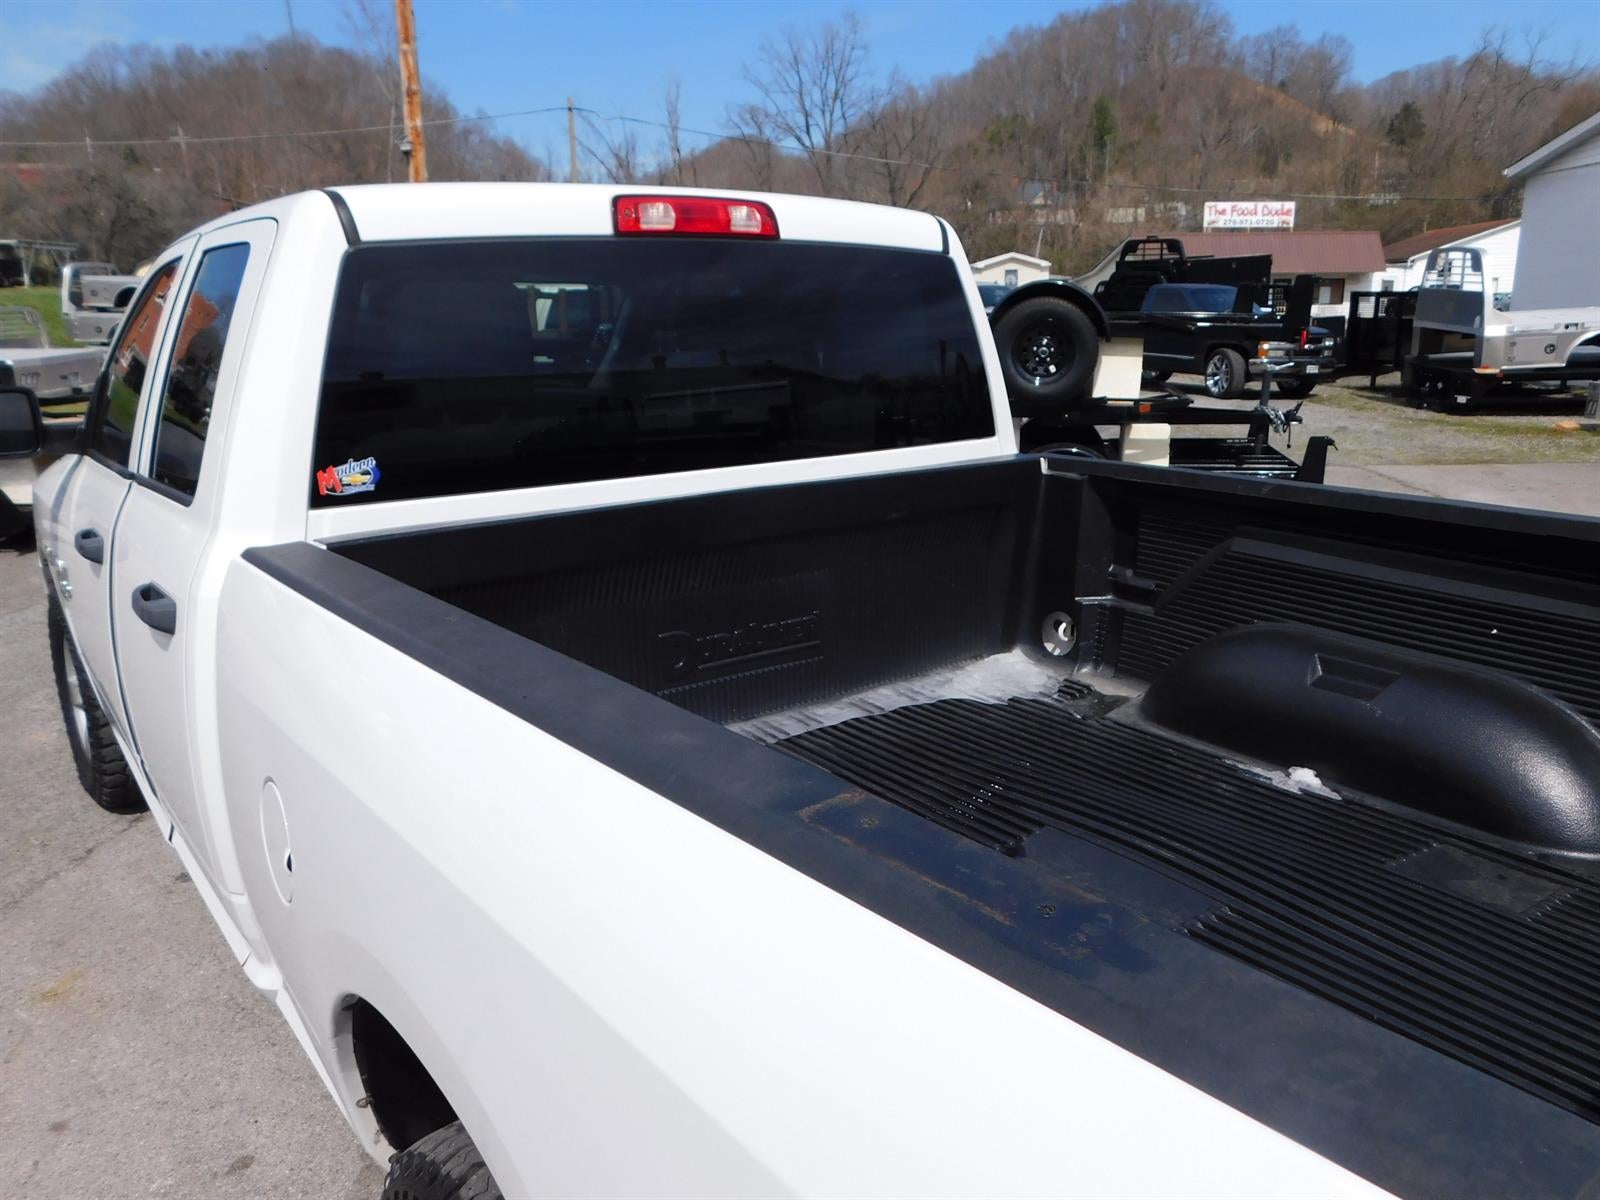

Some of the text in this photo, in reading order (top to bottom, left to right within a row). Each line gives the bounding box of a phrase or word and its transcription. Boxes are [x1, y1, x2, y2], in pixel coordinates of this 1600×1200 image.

[1207, 203, 1293, 218] The Food Dude
[316, 456, 376, 496] Modern
